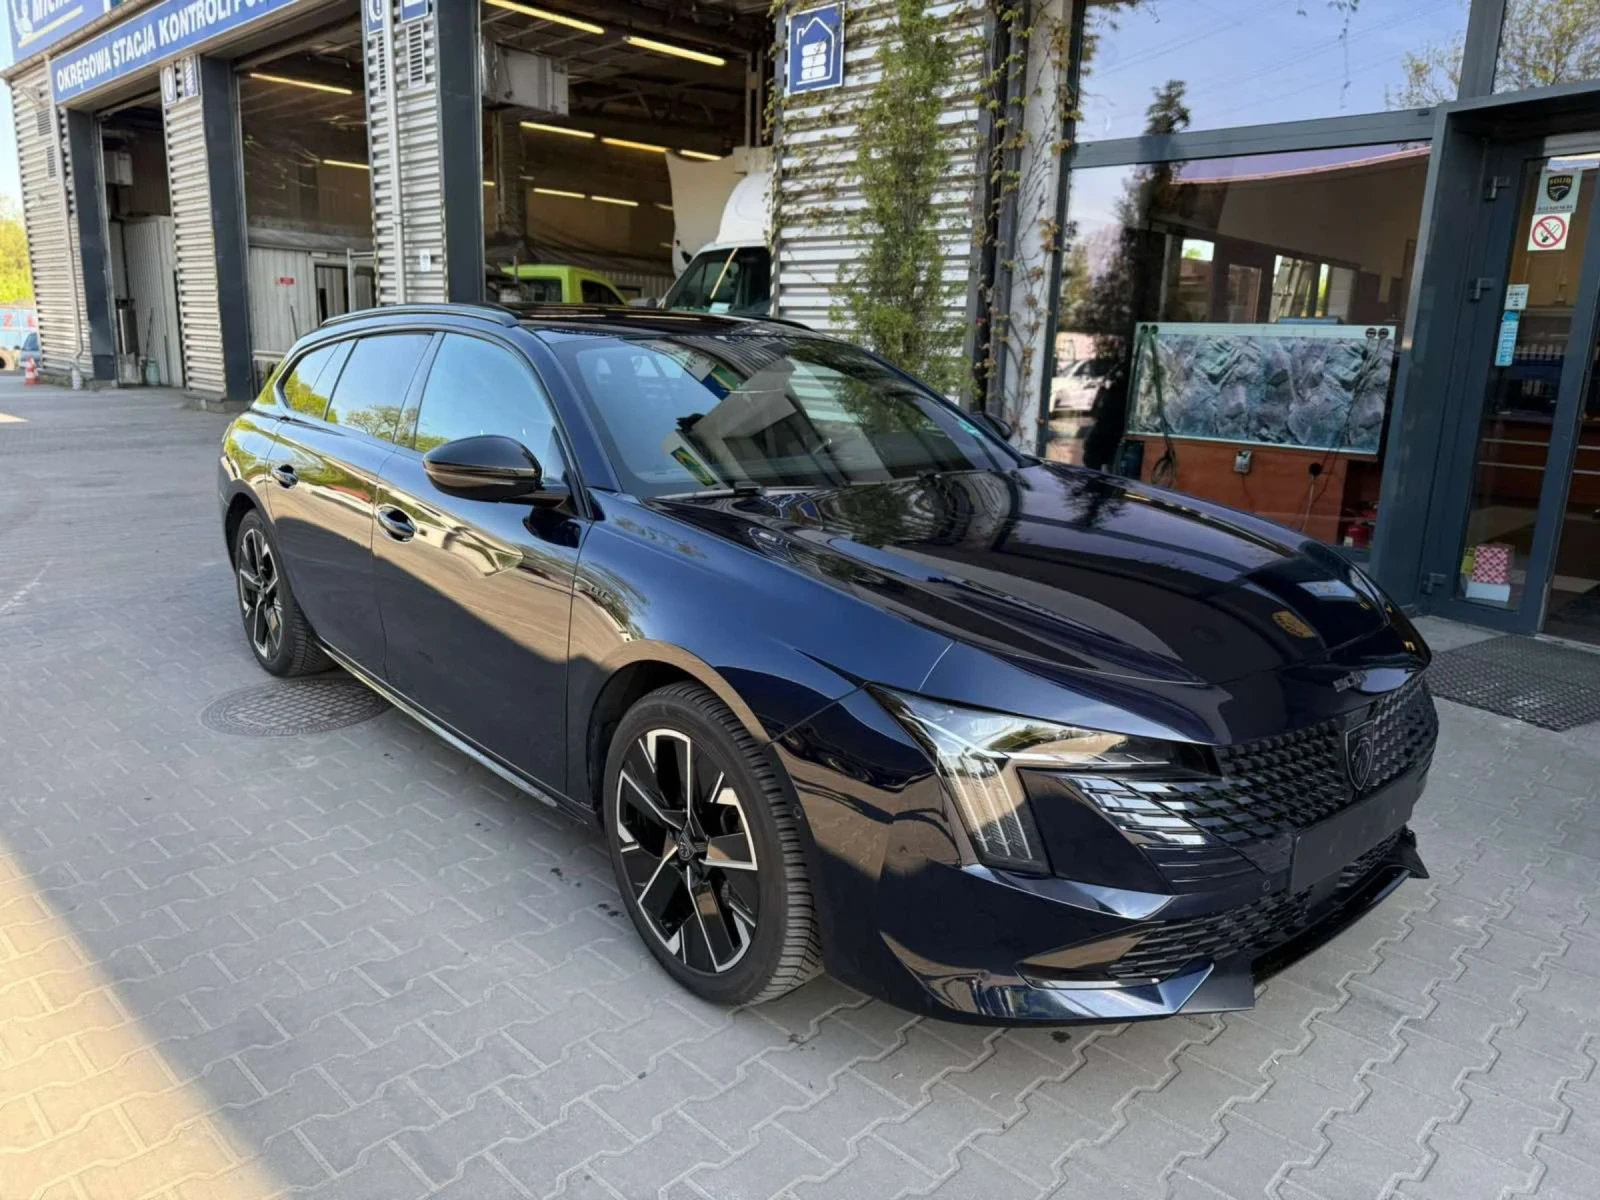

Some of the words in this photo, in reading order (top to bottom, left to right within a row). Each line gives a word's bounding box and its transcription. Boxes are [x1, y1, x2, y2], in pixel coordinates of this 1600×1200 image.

[57, 46, 112, 92] OKRĘGOWA
[112, 24, 156, 67] STACJA
[158, 0, 231, 46] KONTROLI
